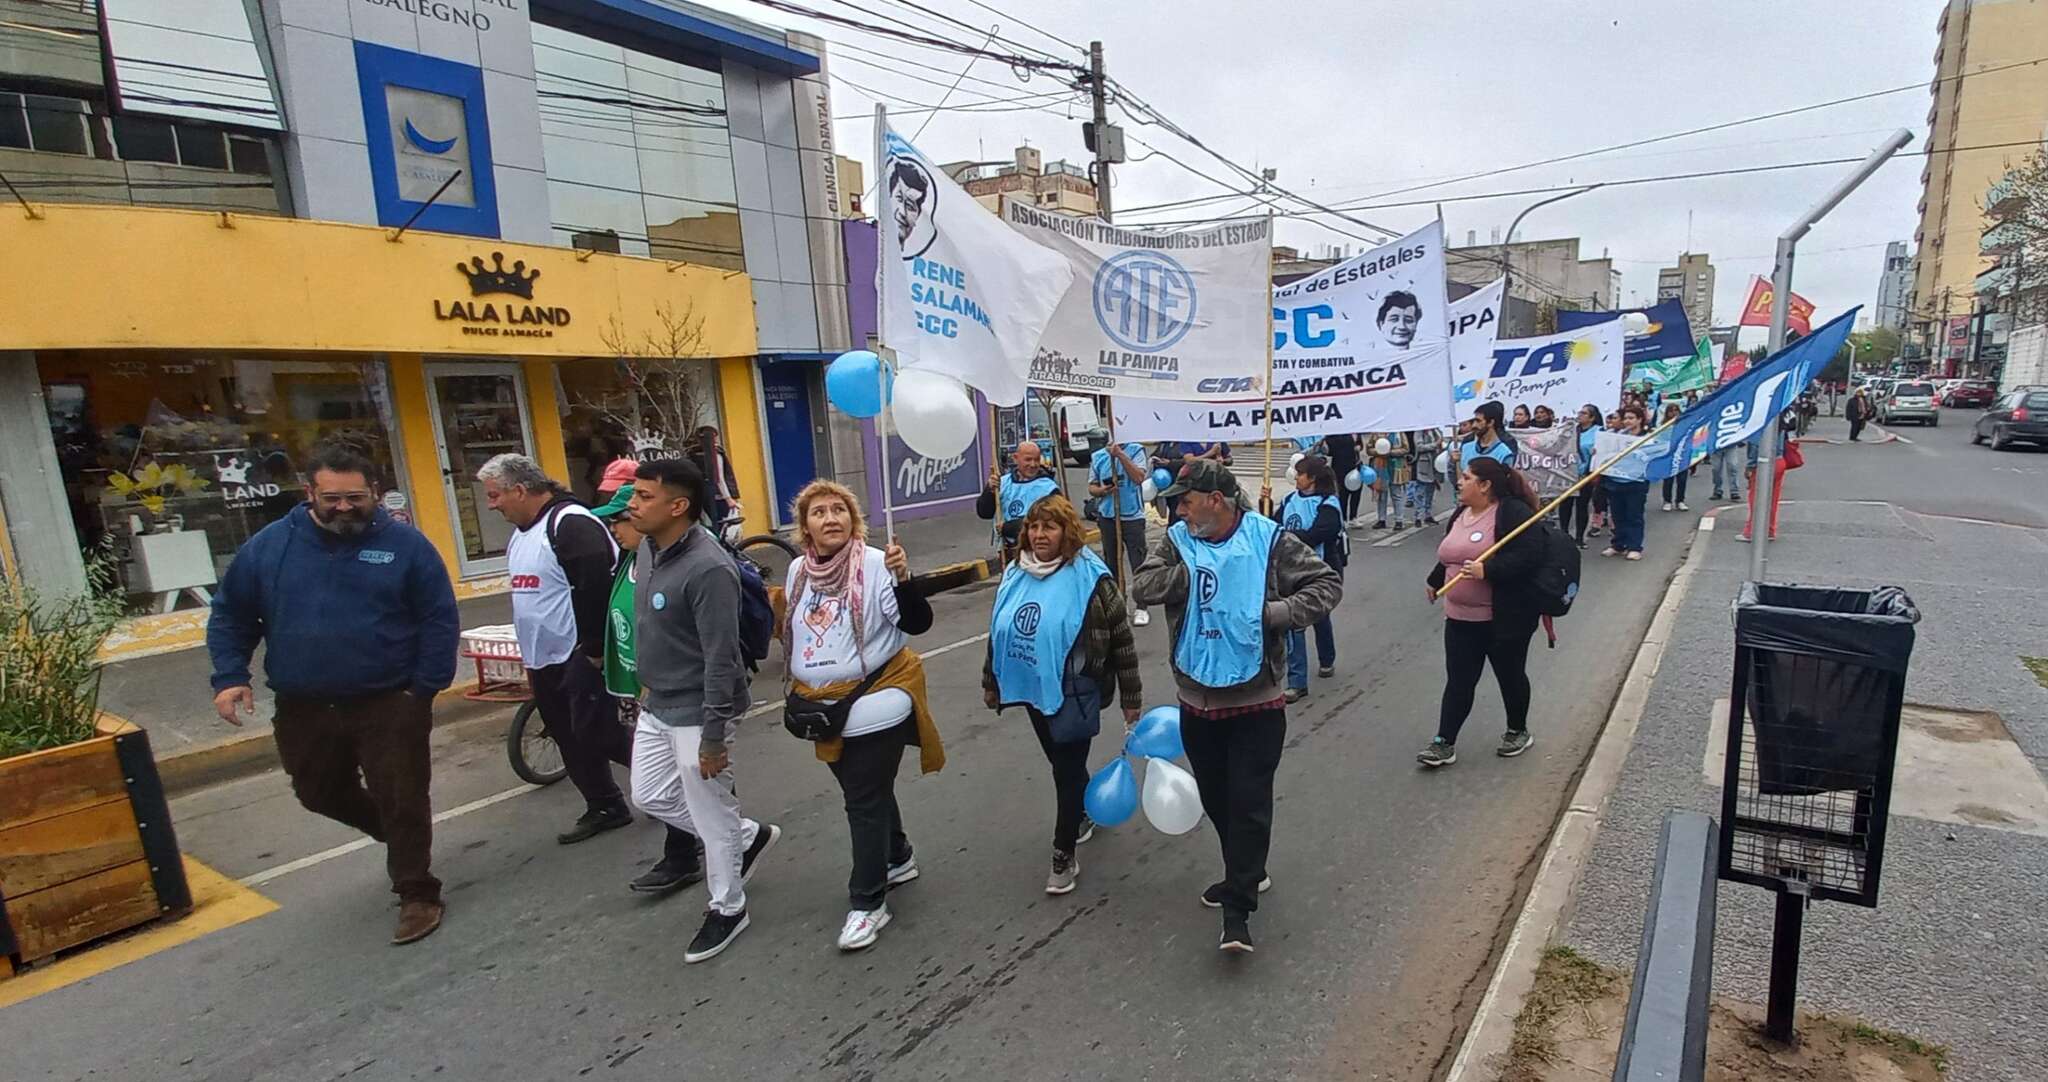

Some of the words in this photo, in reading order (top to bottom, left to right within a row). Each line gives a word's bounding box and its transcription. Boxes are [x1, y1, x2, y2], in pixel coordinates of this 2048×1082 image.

[366, 0, 490, 31] ALEGNO
[1011, 202, 1095, 242] ASOCIACIÓN
[1097, 224, 1200, 249] TRABAJADORES
[1202, 231, 1224, 248] DEL
[1225, 220, 1268, 246] ESTADO
[912, 257, 966, 290] RENE
[1306, 278, 1330, 293] de
[1334, 244, 1426, 286] Estatales
[434, 300, 501, 323] LALA
[506, 304, 571, 327] LAND
[1098, 254, 1190, 347] ATE
[462, 326, 499, 336] DULCE
[1100, 350, 1121, 367] LA
[1121, 353, 1179, 371] PAMPA
[1291, 358, 1297, 368] Y
[1299, 356, 1355, 369] COMBATIVA
[1504, 378, 1568, 397] Pampa
[1208, 410, 1242, 428] LA
[1252, 403, 1342, 426] PAMPA
[650, 450, 681, 462] LAND
[222, 484, 280, 500] LAND
[1015, 604, 1040, 634] ATE
